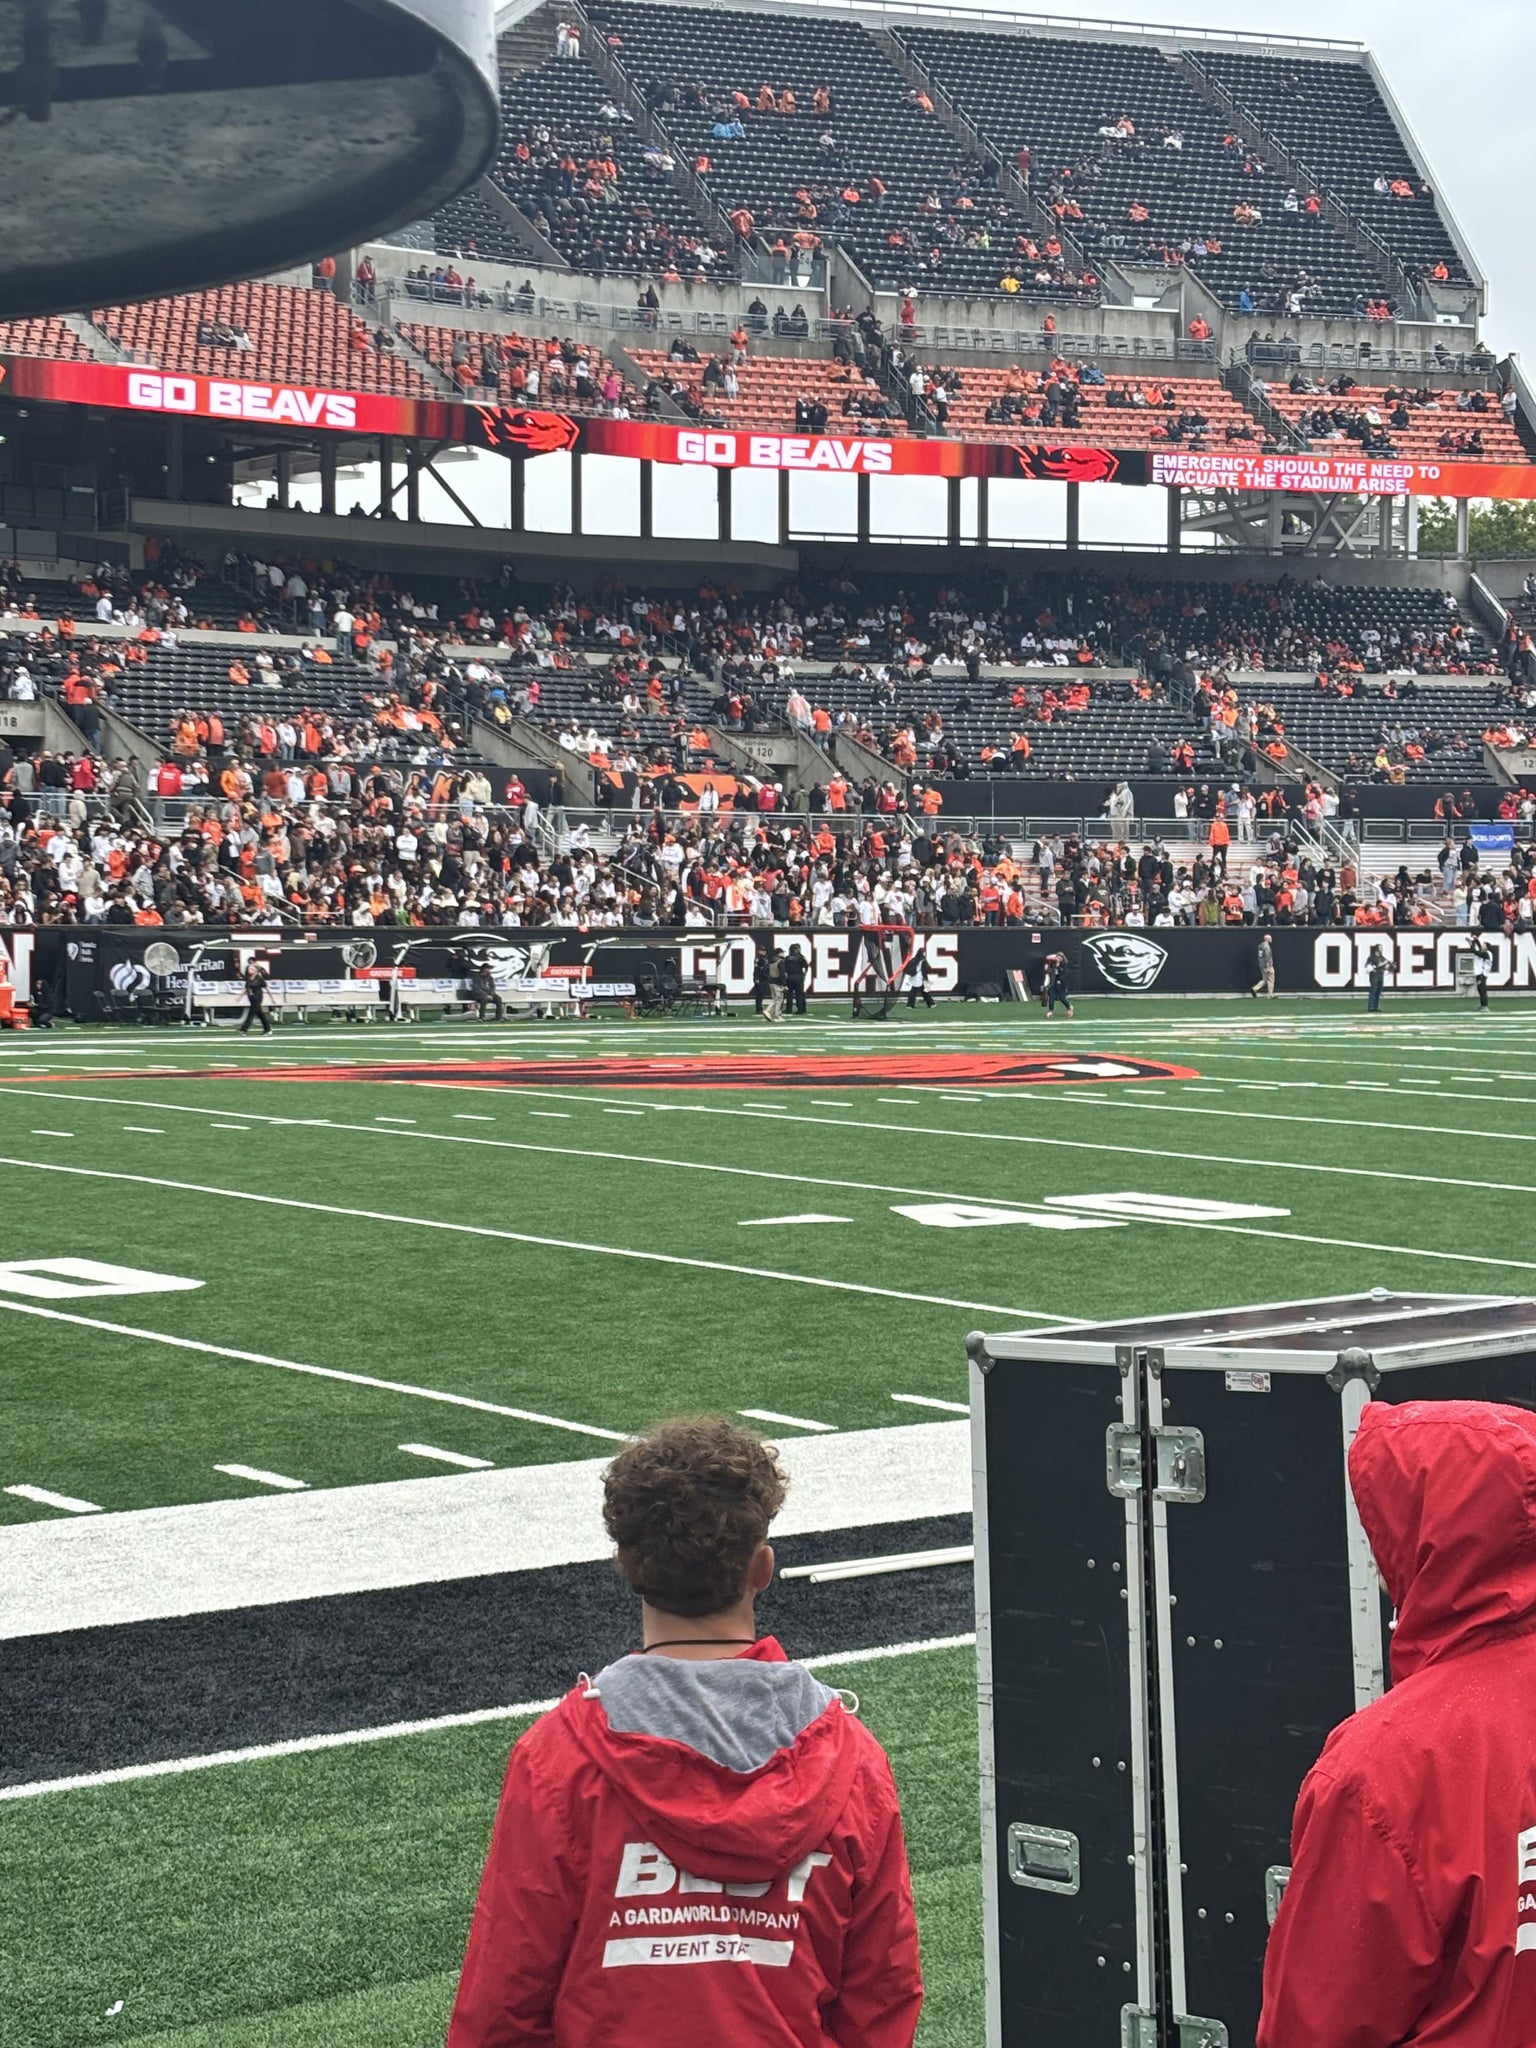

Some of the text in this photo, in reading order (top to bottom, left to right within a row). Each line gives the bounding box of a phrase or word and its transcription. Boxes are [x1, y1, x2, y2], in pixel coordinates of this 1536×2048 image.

[128, 373, 356, 427] GO BEAVS
[677, 431, 892, 471] GO BEAVS
[1153, 454, 1440, 480] EMERGENCY, SHOULD THE NEED TO
[1153, 469, 1410, 494] EVACUATE THE STADIUM ARISE,
[757, 747, 773, 758] 120
[681, 934, 755, 993] GO
[615, 1842, 833, 1901] BT
[609, 1911, 622, 1927] A
[732, 1909, 799, 1929] OMPANY
[650, 1941, 709, 1958] EVENT
